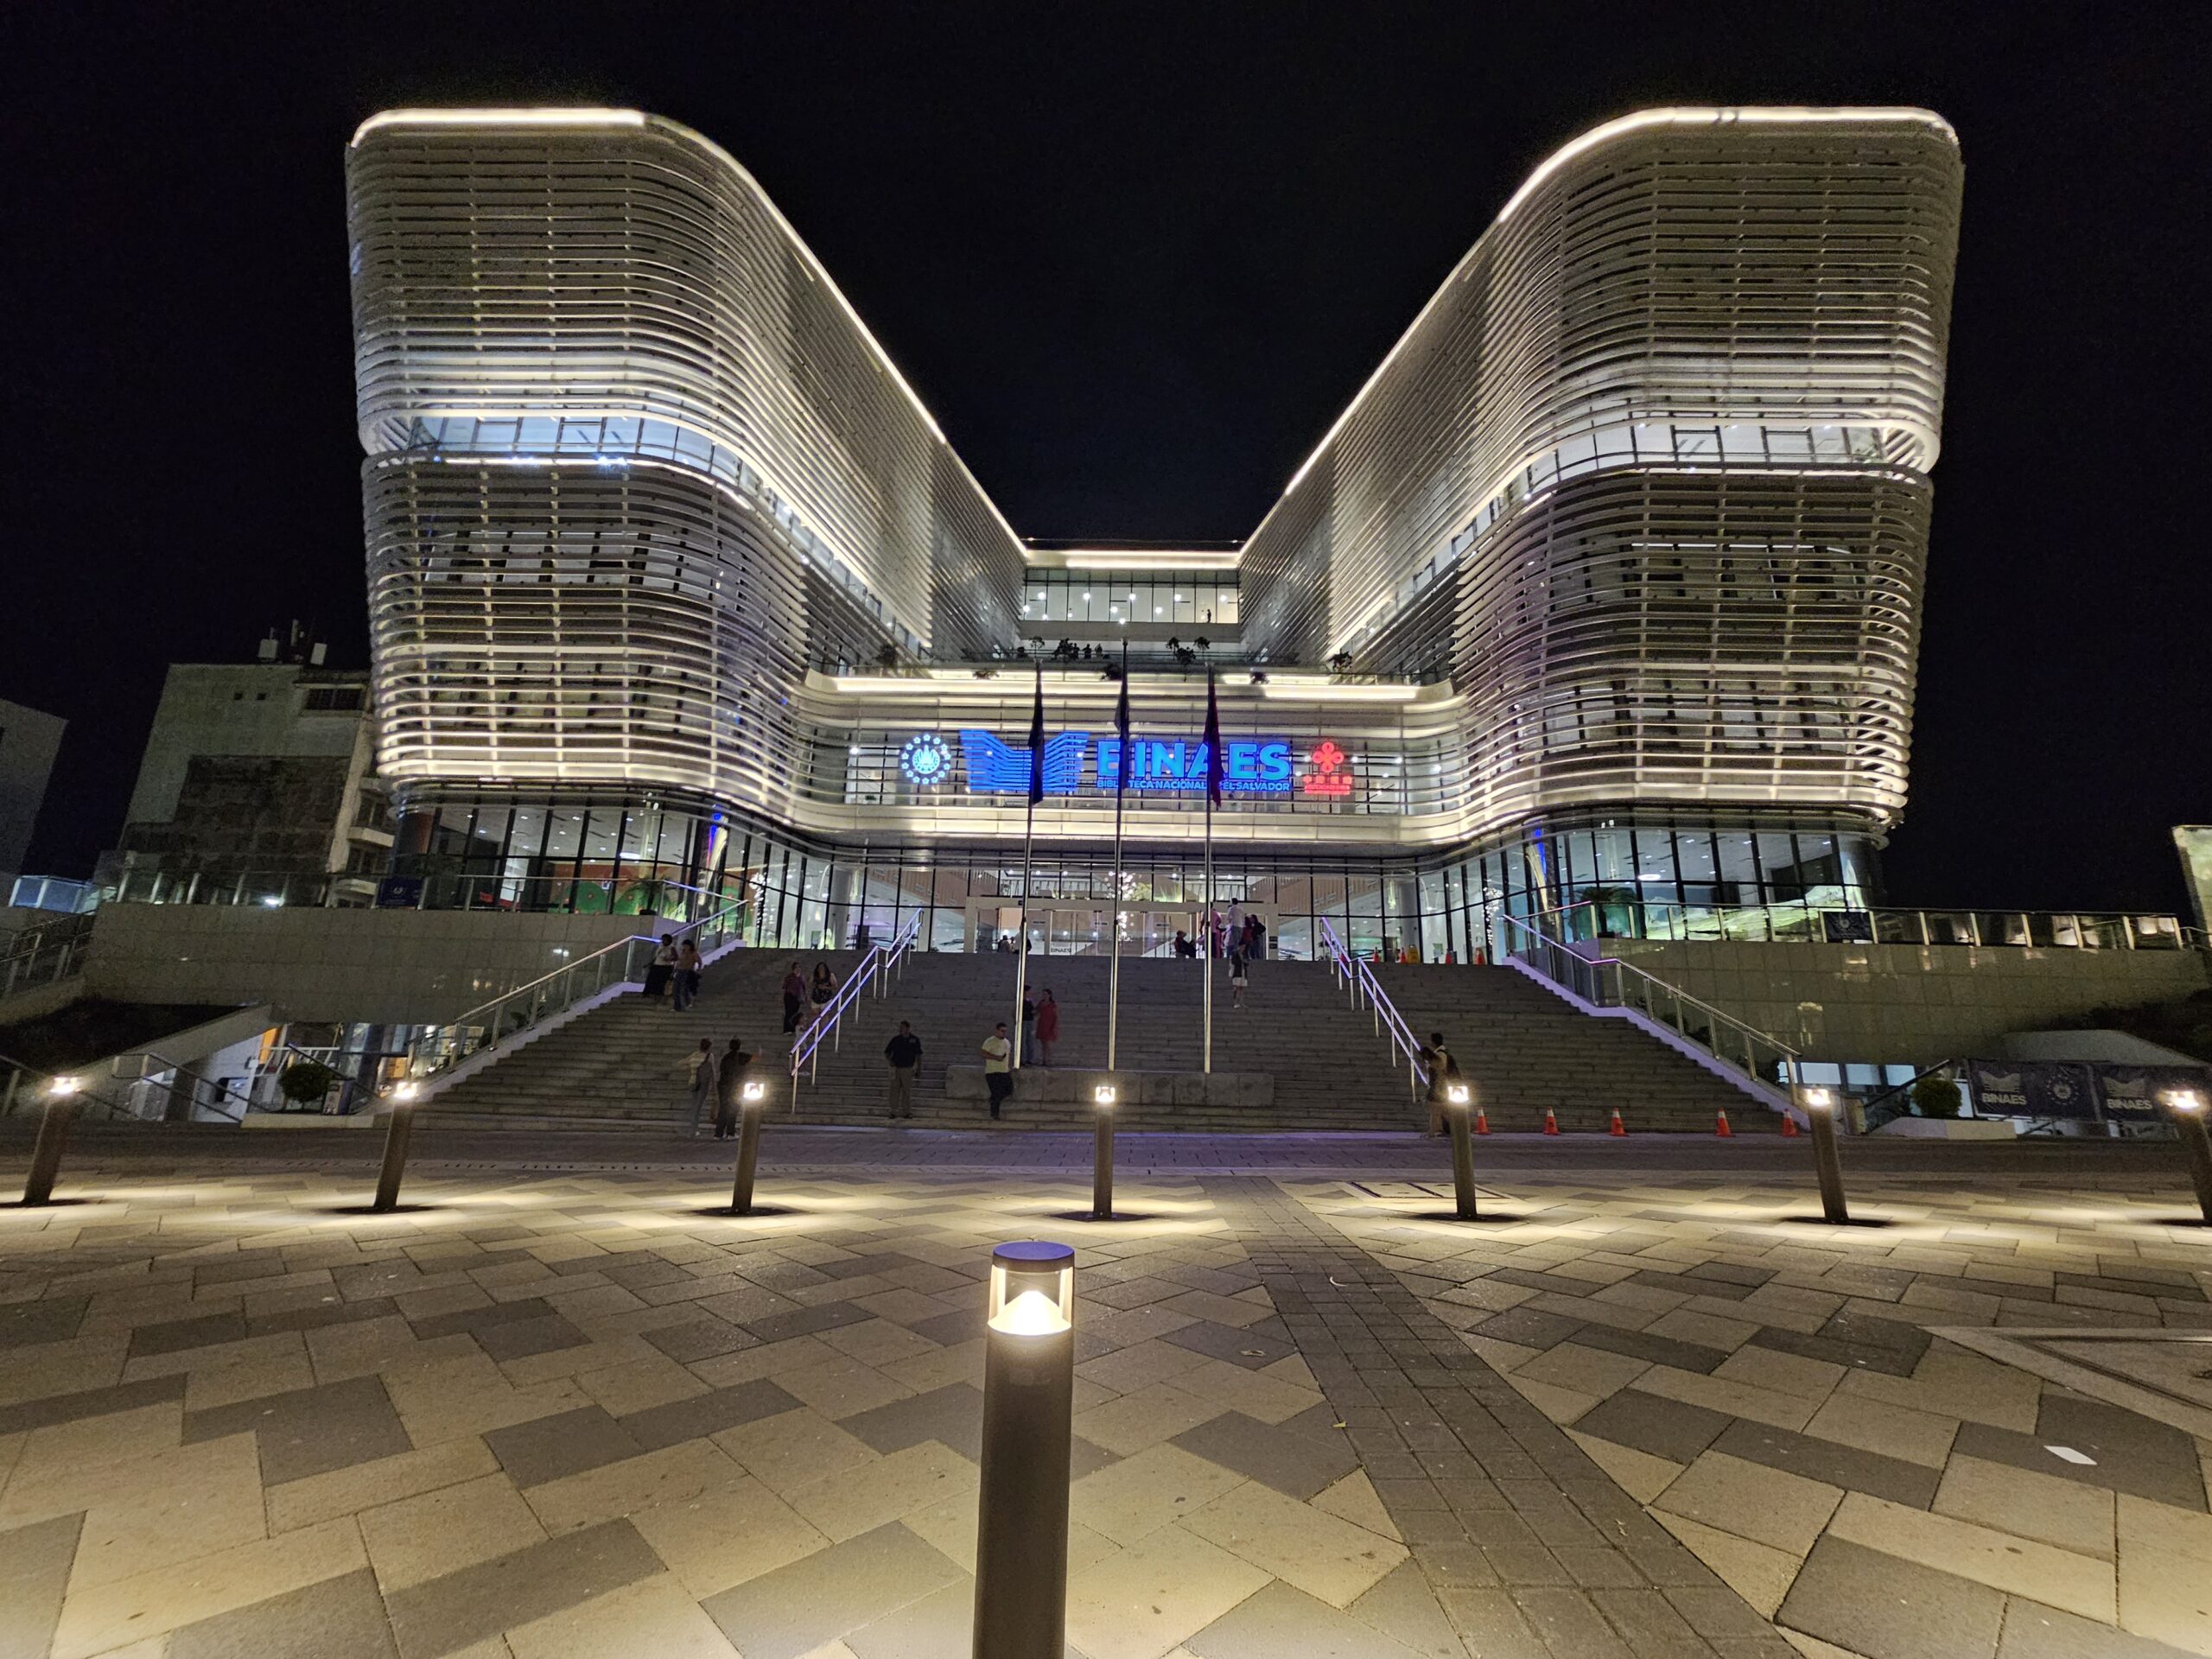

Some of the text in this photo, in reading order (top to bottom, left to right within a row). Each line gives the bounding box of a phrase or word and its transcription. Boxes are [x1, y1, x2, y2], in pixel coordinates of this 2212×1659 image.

[1154, 780, 1207, 790] NACIONAL
[1223, 781, 1235, 790] EL
[1236, 781, 1290, 791] SALVADOR
[1981, 1092, 2027, 1105] BINAES
[2107, 1098, 2152, 1109] BINAES
